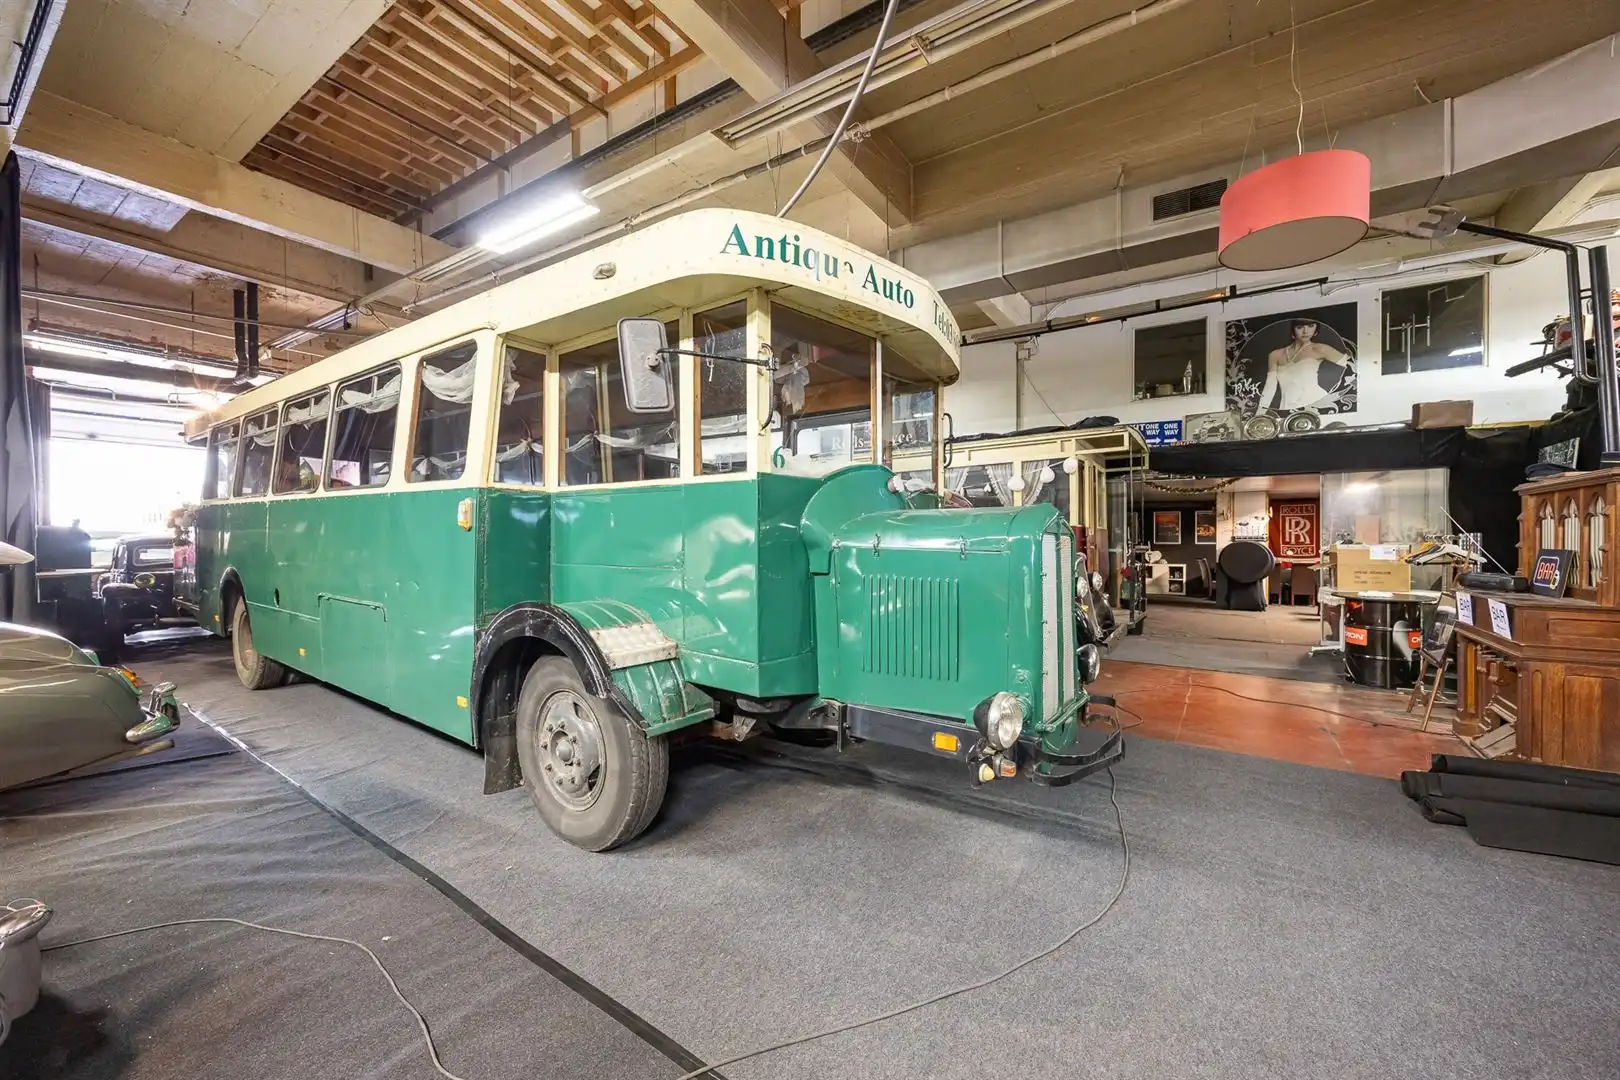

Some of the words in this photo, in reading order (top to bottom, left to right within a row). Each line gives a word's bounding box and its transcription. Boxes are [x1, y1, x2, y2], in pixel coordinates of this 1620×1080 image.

[720, 223, 854, 282] Antiqu
[862, 264, 914, 309] Auto
[1283, 506, 1313, 514] ROLLS
[1283, 546, 1313, 556] ROYCE
[1537, 562, 1556, 580] BAR
